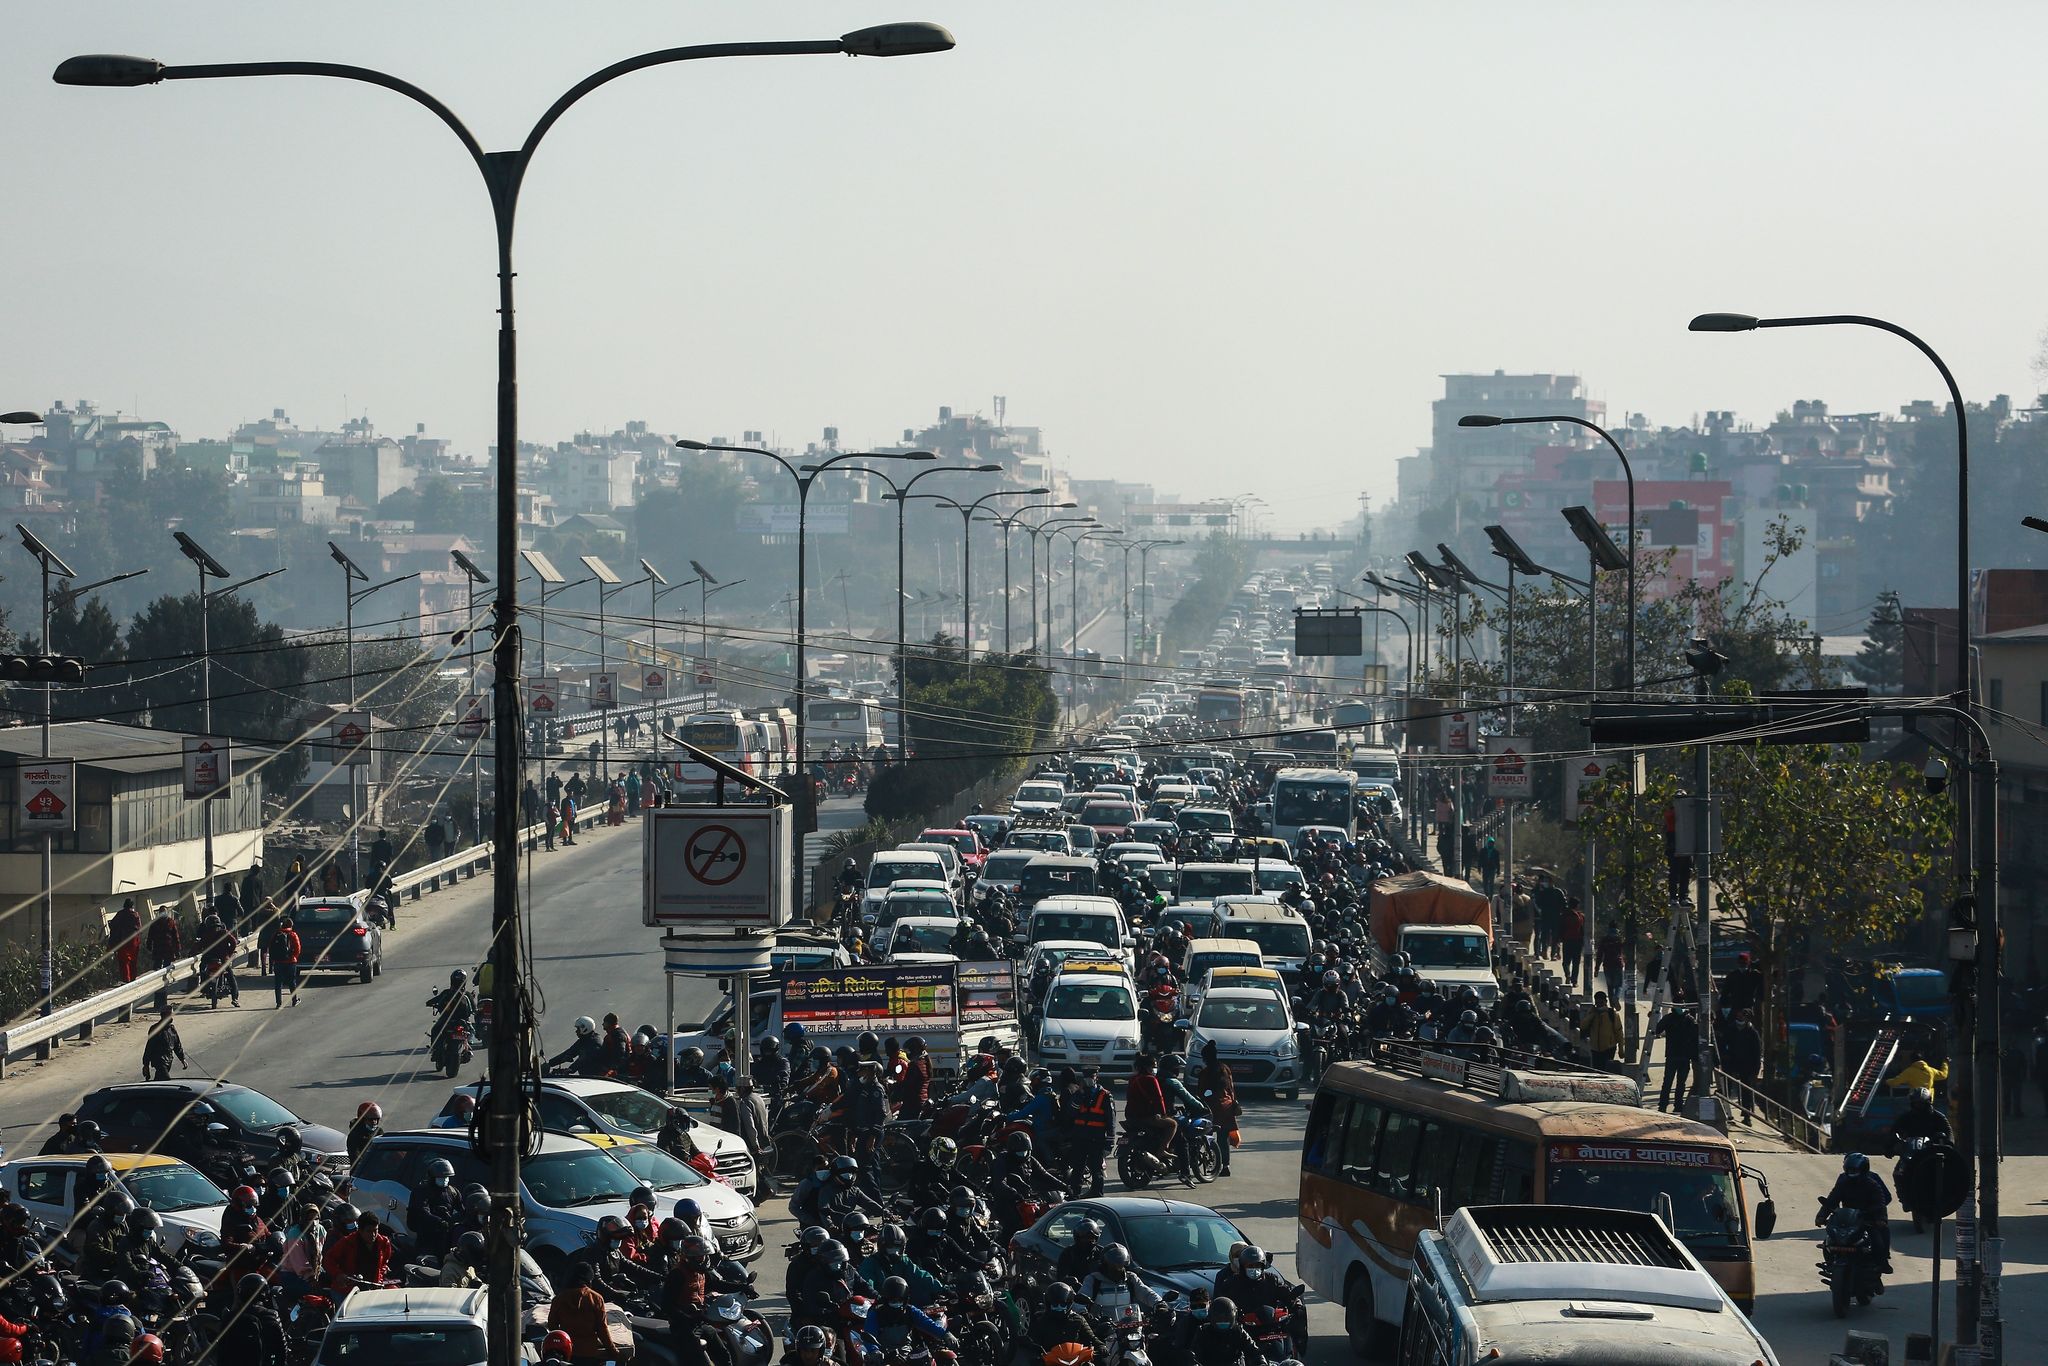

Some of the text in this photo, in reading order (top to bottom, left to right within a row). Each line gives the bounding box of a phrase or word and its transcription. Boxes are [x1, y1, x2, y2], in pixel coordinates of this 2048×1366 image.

[807, 976, 886, 993] अग्नि सिमेन्ट
[1579, 1145, 1630, 1159] नेपाल
[1637, 1149, 1709, 1164] यातायात
